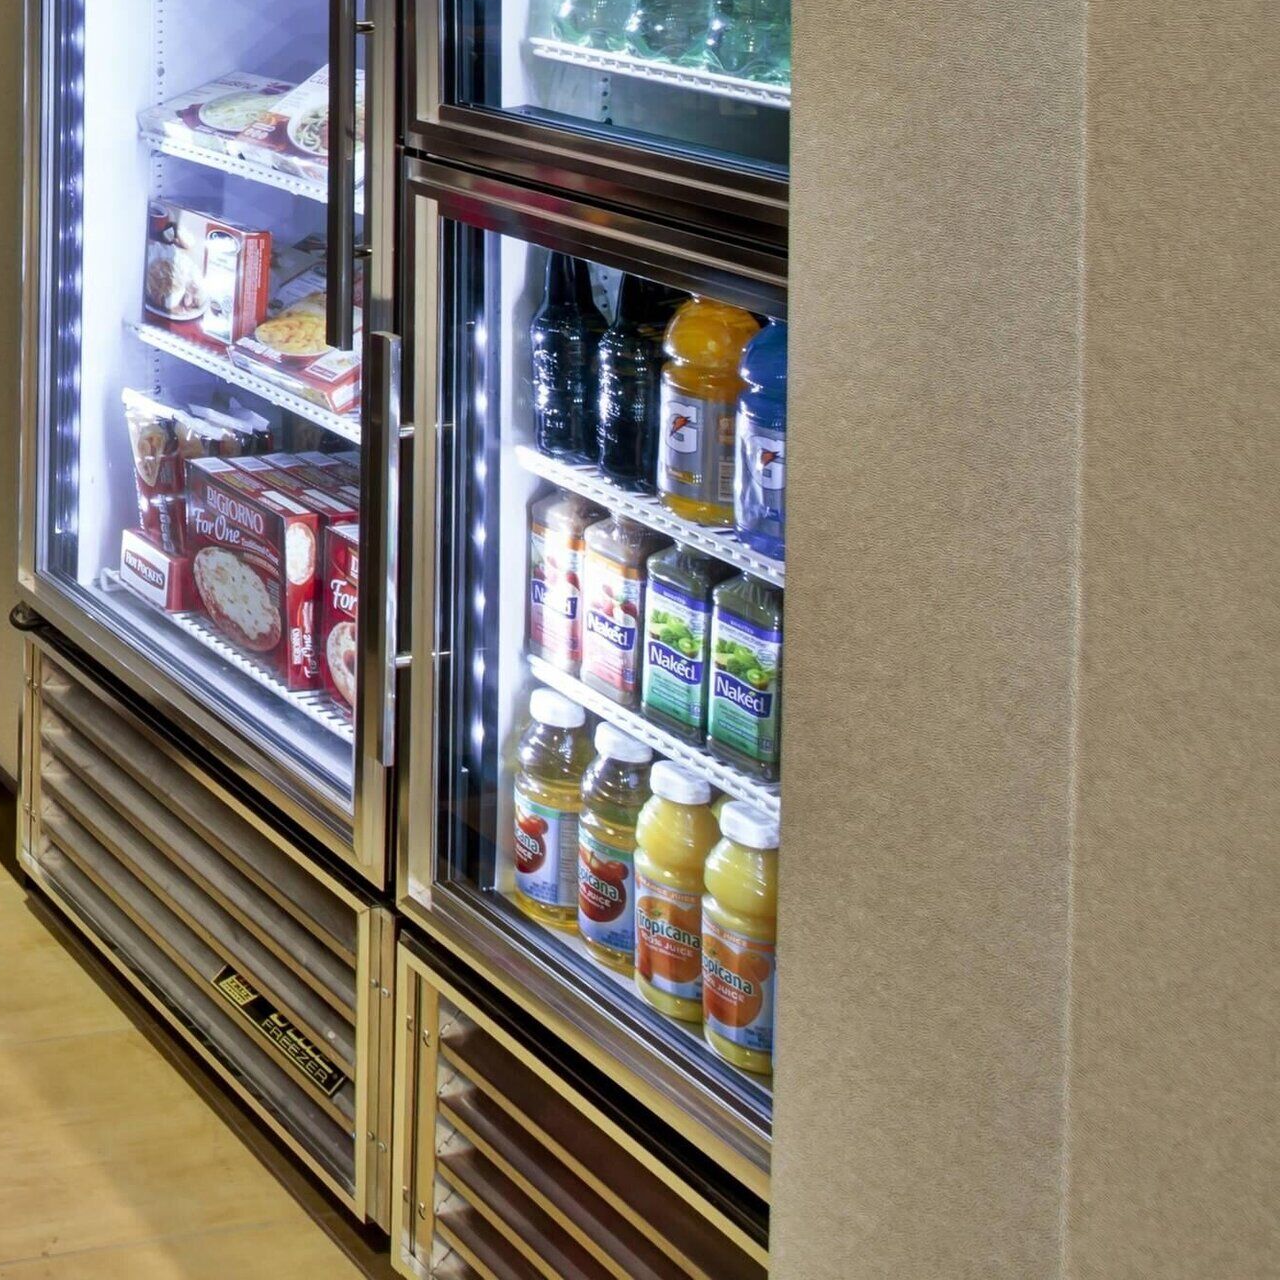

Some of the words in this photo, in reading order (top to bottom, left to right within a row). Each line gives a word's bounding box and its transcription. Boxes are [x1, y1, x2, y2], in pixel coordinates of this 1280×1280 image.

[193, 507, 214, 534] For
[215, 515, 240, 544] One
[588, 613, 628, 646] Naked
[650, 646, 695, 680] Naked
[716, 676, 764, 713] Naked
[637, 909, 701, 949] Tropicana
[261, 1018, 328, 1083] FREEZER
